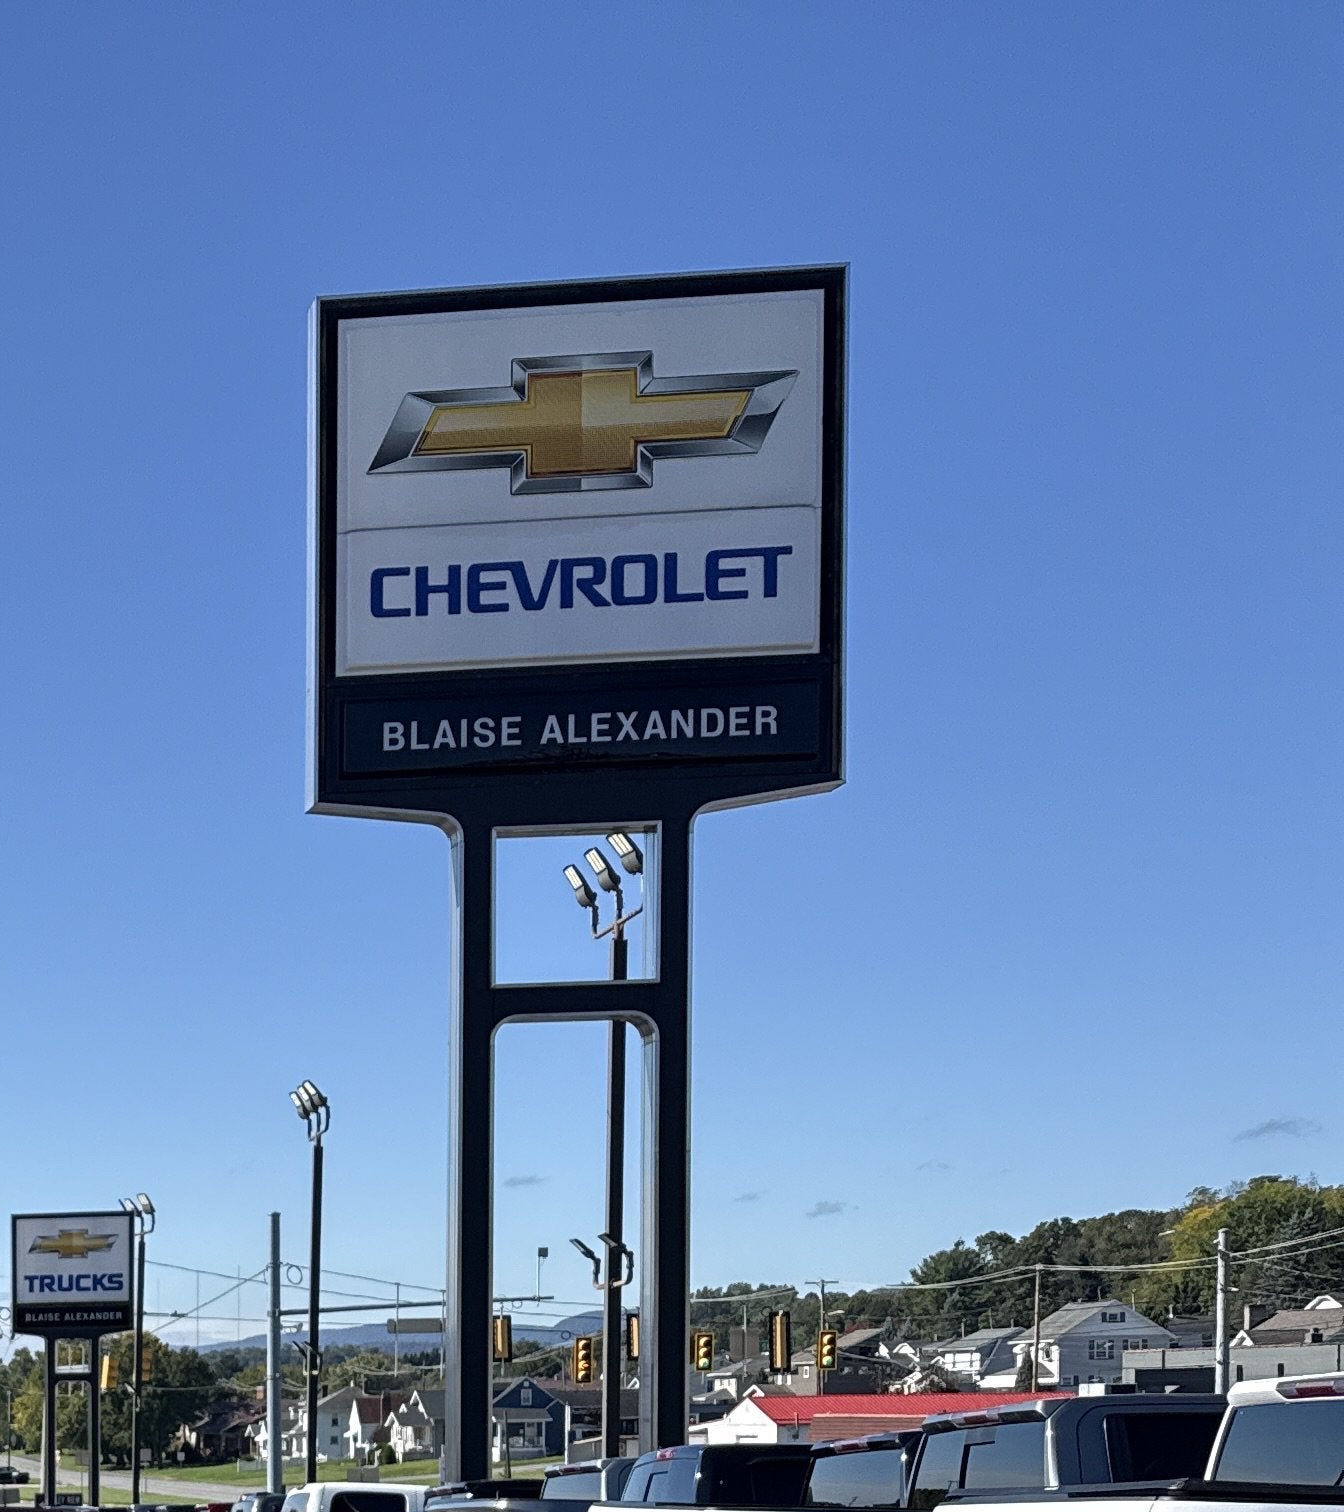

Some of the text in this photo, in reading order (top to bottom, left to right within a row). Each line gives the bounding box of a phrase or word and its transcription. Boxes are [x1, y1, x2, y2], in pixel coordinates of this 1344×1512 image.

[370, 545, 794, 618] CHEVROLET
[382, 704, 779, 752] BLAISE ALEXANDER
[24, 1272, 124, 1293] TRUCKS
[25, 1311, 123, 1322] BLAISE ALEXANDER
